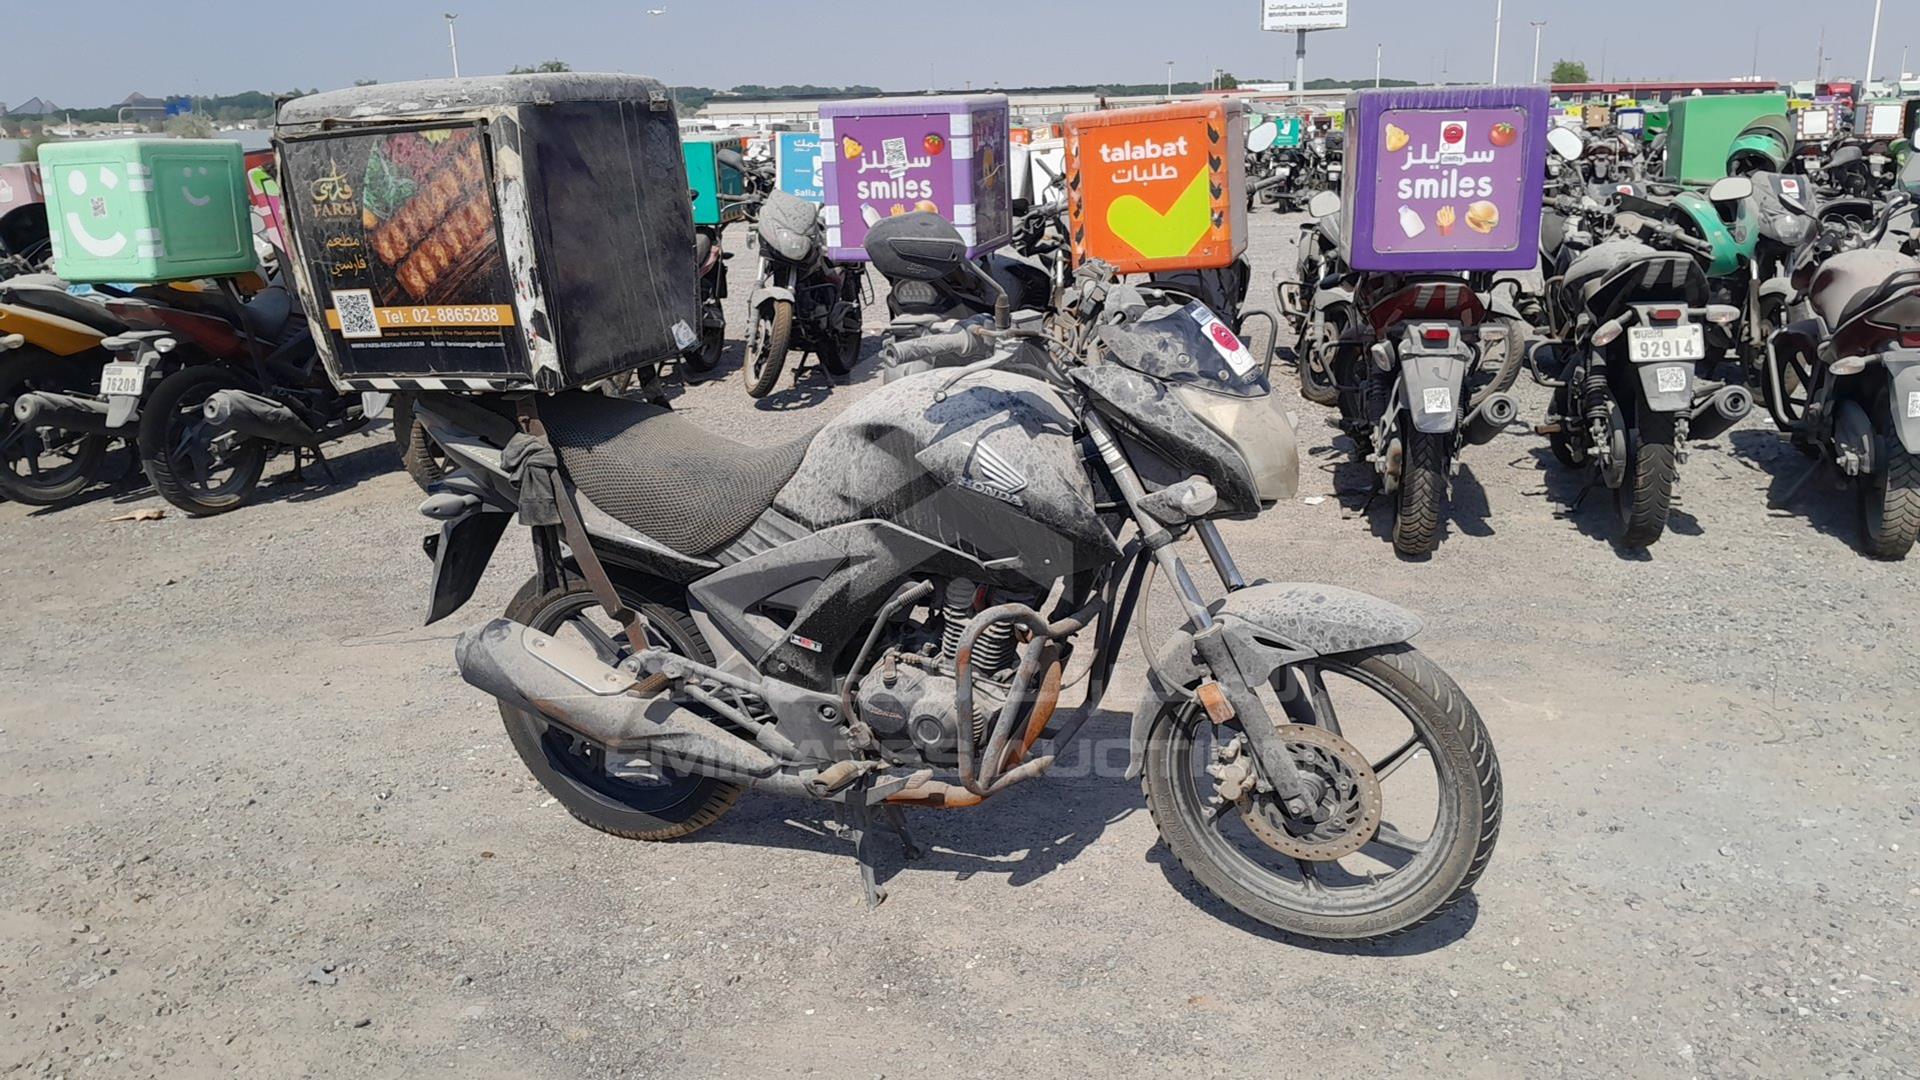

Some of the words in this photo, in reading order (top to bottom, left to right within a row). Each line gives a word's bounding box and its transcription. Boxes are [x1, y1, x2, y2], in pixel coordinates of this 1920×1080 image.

[1098, 135, 1188, 163] talabat
[1111, 162, 1178, 187] طلبات
[1397, 168, 1493, 200] smiles
[857, 176, 933, 200] smiles
[326, 231, 360, 248] مطعم
[330, 253, 367, 277] فارسي
[382, 310, 409, 324] Tel:
[412, 306, 499, 324] 02-8865288
[1640, 340, 1694, 358] 92914
[106, 377, 136, 392] 76208
[959, 477, 1024, 507] HONDA
